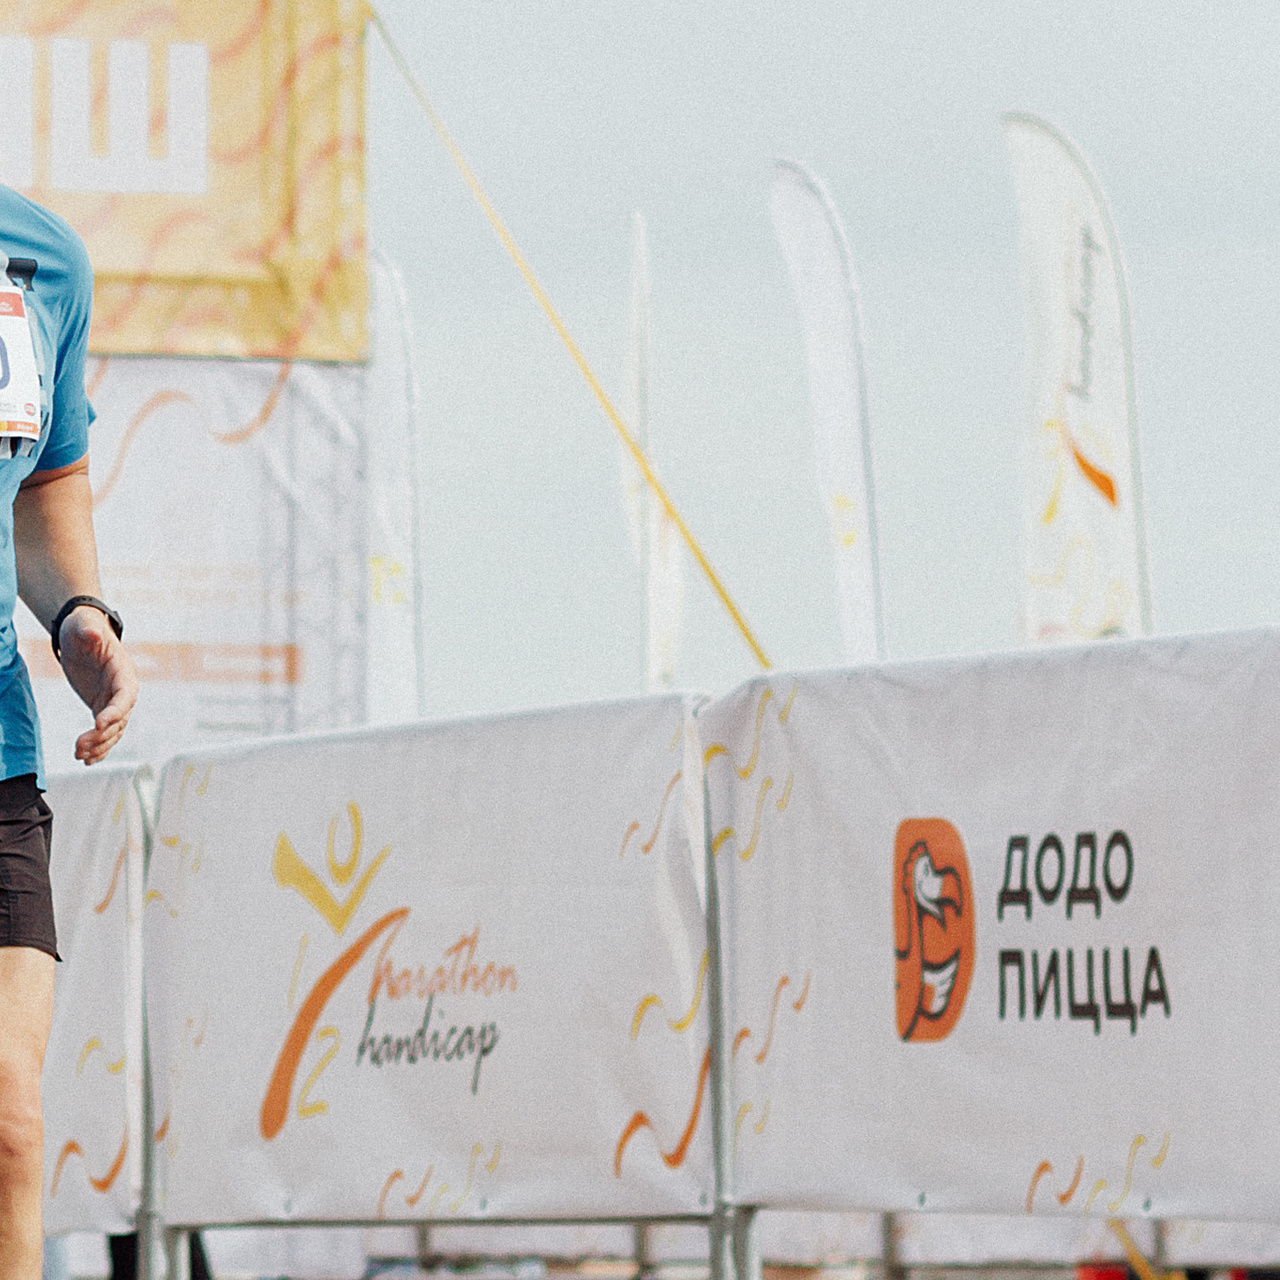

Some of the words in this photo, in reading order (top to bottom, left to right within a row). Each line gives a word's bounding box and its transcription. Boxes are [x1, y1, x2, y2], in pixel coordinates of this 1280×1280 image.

[997, 830, 1135, 921] ДОДО
[999, 946, 1172, 1036] ПИЦЦА
[356, 994, 501, 1097] handicap
